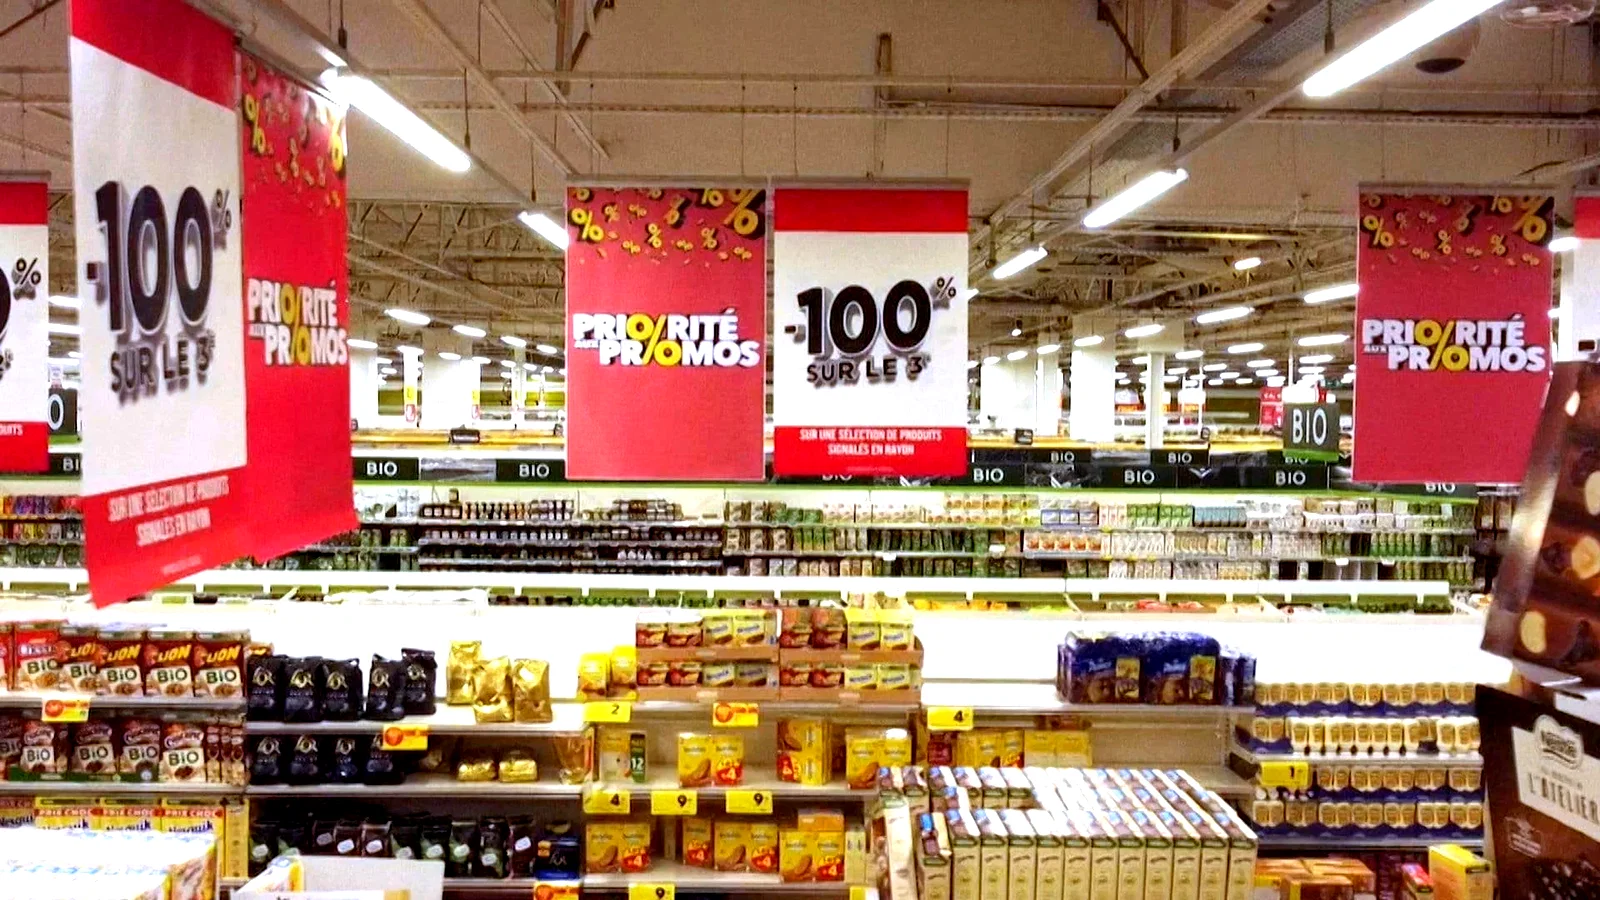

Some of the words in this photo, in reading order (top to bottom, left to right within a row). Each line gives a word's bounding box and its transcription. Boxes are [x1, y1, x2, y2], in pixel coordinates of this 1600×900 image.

[111, 347, 154, 392] SUR
[162, 340, 189, 378] LE
[807, 362, 854, 382] SUR
[866, 357, 898, 378] LE
[1293, 408, 1327, 446] BIO
[819, 429, 836, 441] UNE
[1051, 452, 1075, 463] BIO
[1168, 452, 1193, 463] BIO
[366, 461, 398, 475] BIO
[518, 464, 550, 478] BIO
[973, 467, 1004, 483] BIO
[1124, 469, 1155, 484] BIO
[1275, 470, 1306, 486] BIO
[107, 644, 141, 662] LION
[157, 643, 192, 662] LION
[206, 644, 241, 663] LION
[631, 758, 644, 771] 12
[610, 793, 620, 806] 4
[677, 794, 687, 807] 9
[754, 793, 763, 806] 9
[656, 886, 665, 900] 9
